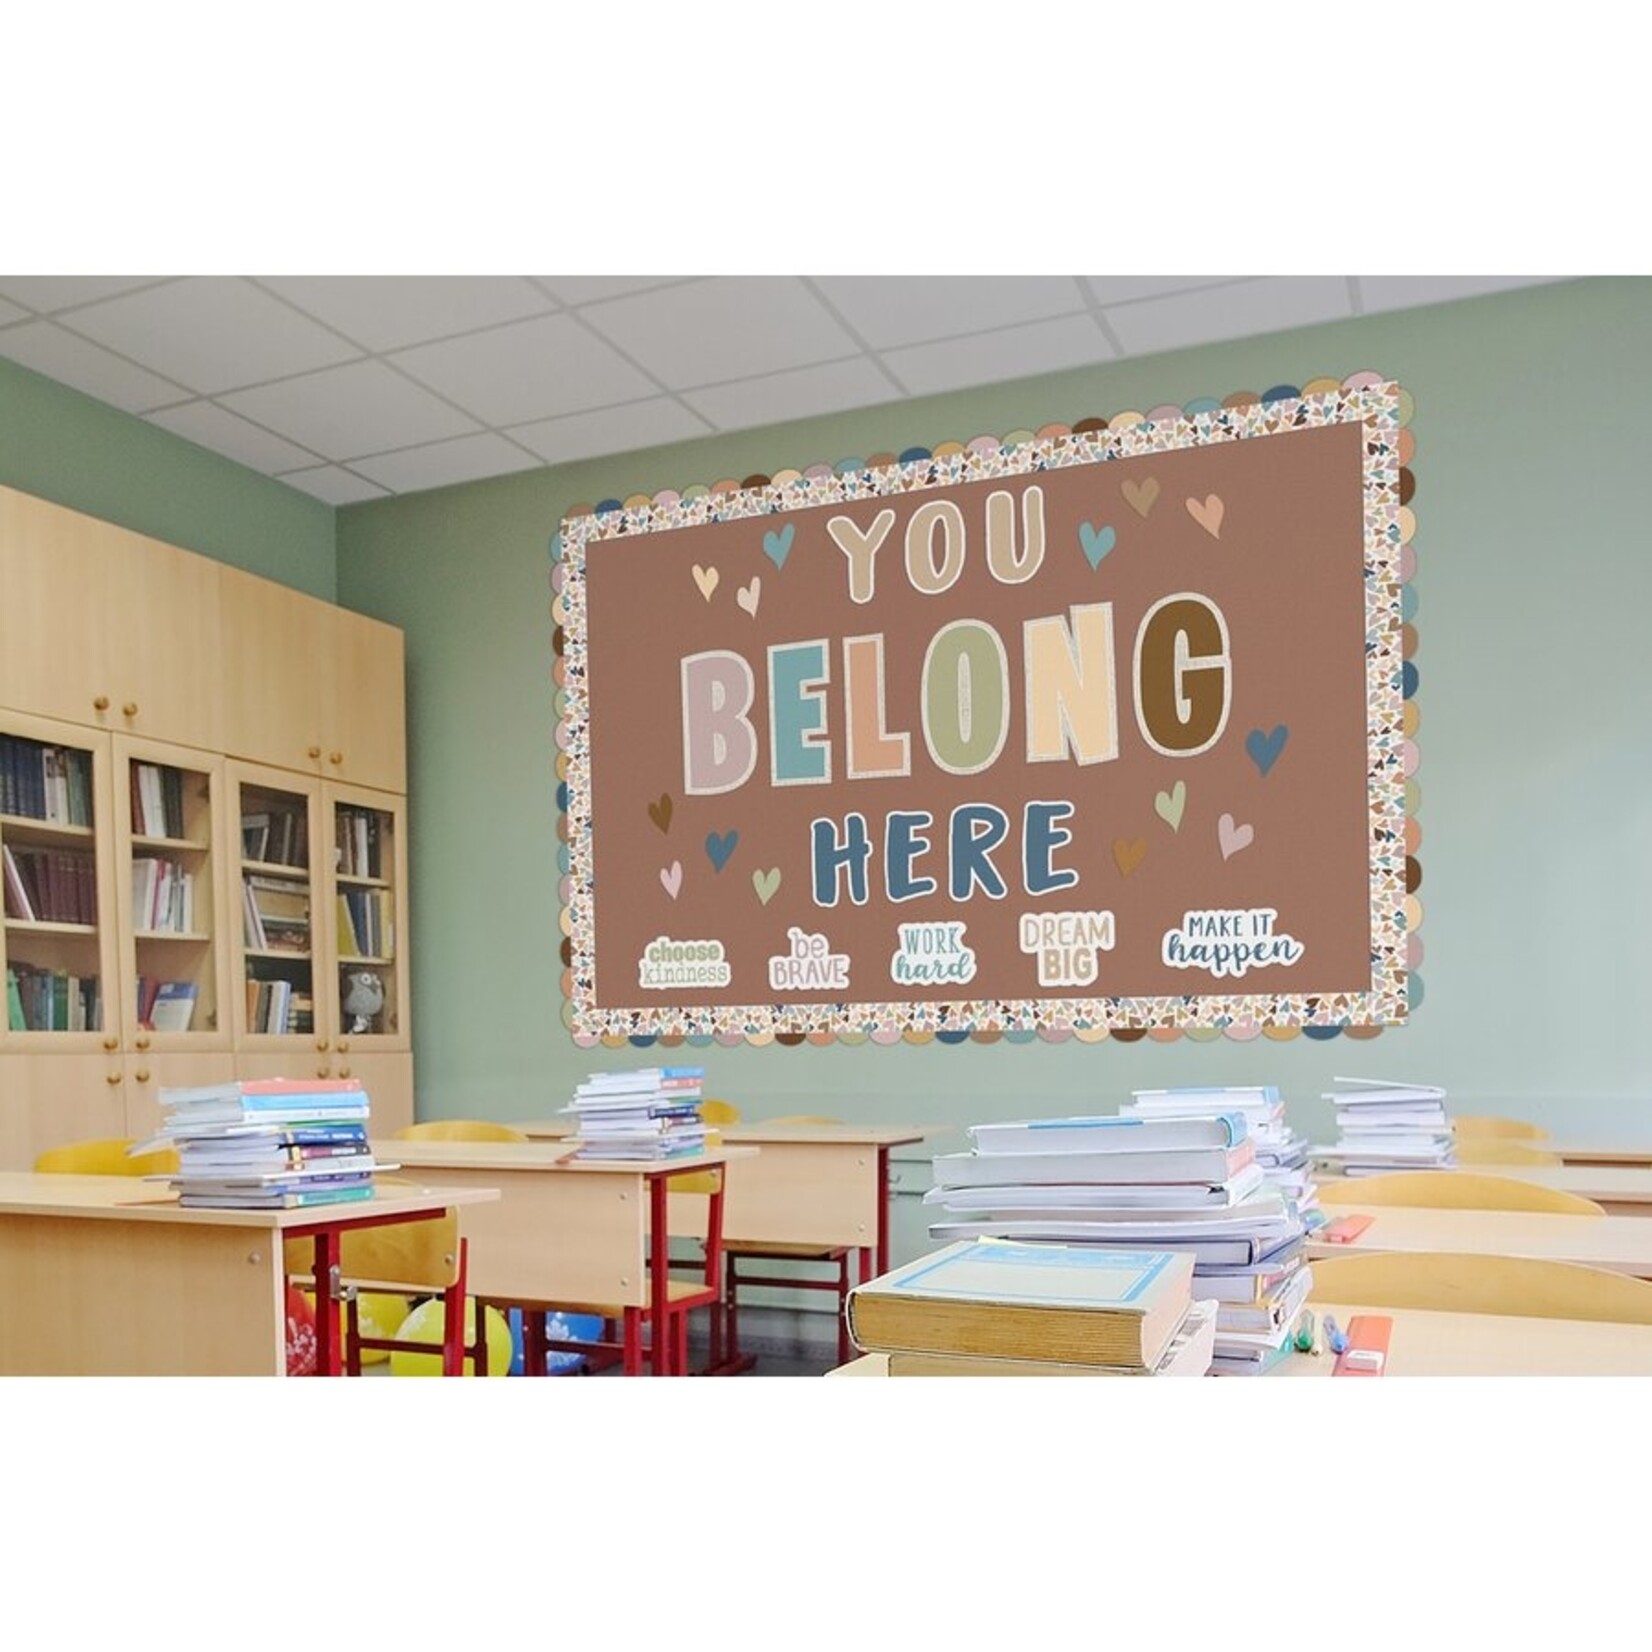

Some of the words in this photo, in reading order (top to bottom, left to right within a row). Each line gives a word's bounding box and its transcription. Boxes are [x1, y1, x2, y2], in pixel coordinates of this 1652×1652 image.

[827, 486, 1046, 604] YOU
[680, 592, 1232, 796] BELONG
[811, 801, 1078, 907] HERE
[1023, 917, 1110, 948] DREAM
[1188, 915, 1243, 937] MAKE
[1252, 913, 1272, 937] IT
[649, 941, 722, 963] choose
[792, 931, 825, 959] be
[904, 926, 962, 954] WORK
[1167, 933, 1300, 972] happen
[643, 963, 729, 985] kindness
[773, 957, 846, 986] BRAVE
[895, 952, 972, 980] hard
[1043, 948, 1093, 980] BIG
